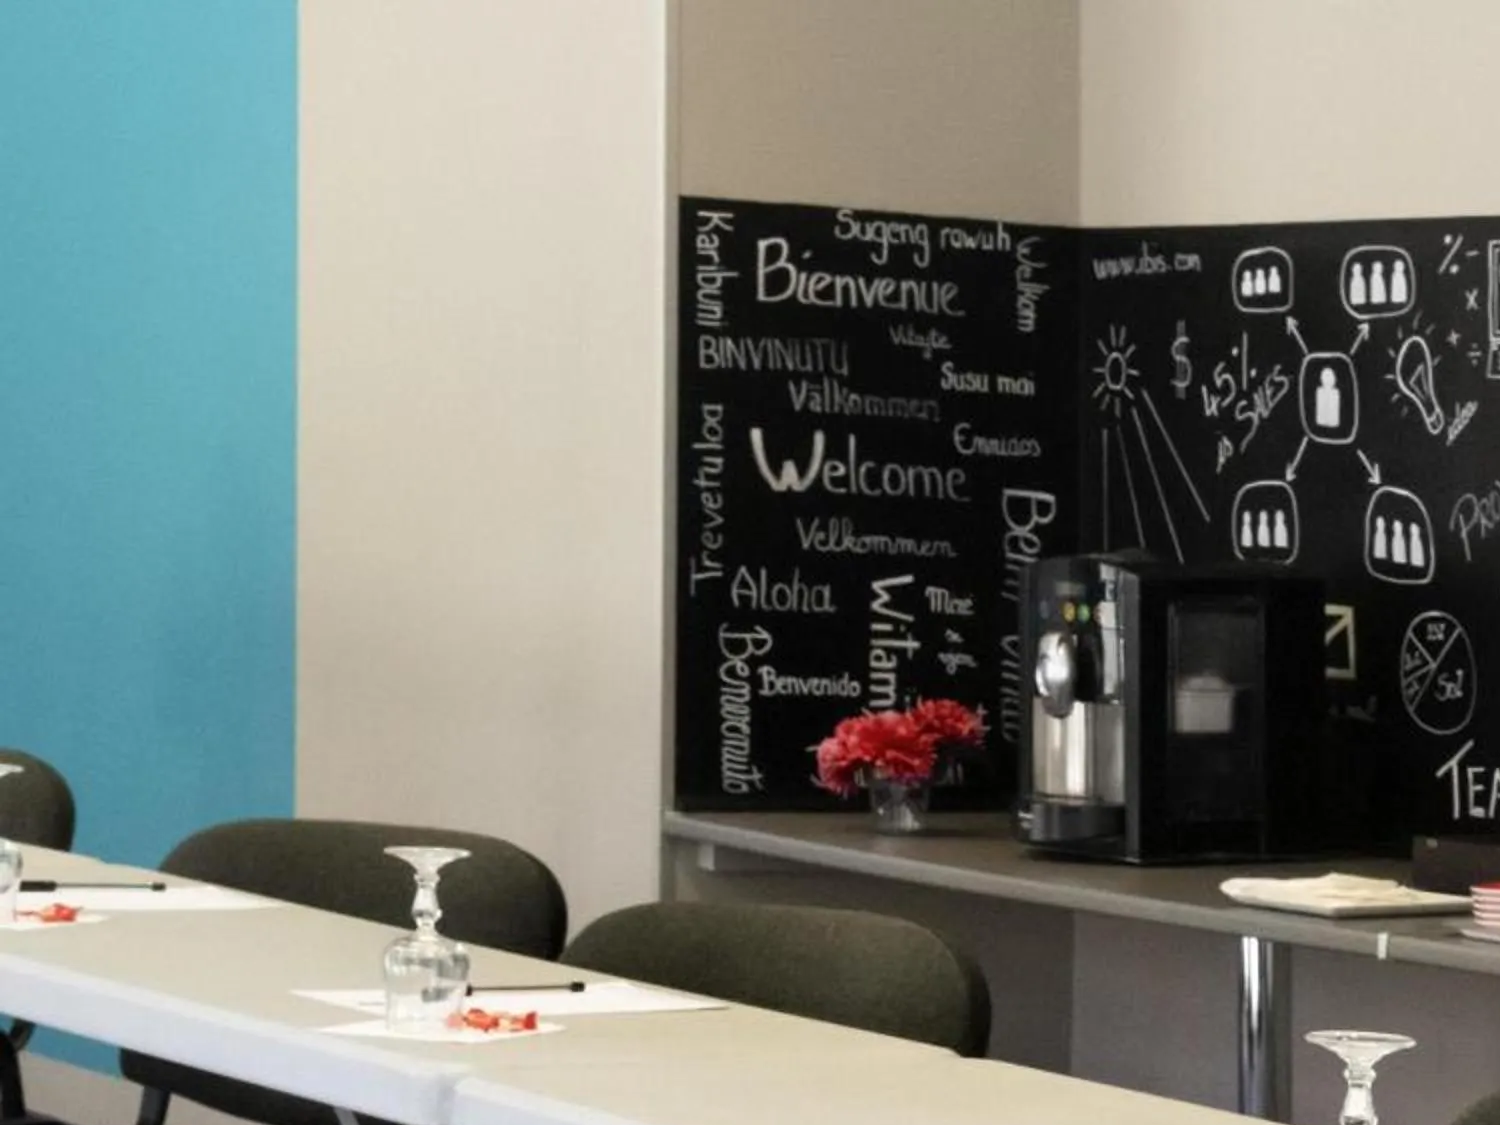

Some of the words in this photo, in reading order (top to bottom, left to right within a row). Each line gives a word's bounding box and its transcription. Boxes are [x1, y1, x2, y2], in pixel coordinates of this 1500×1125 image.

[695, 210, 740, 328] Karibuni
[834, 208, 930, 267] Sugeng
[940, 220, 1012, 252] rawuh
[755, 236, 966, 317] Bienvenue
[940, 361, 990, 393] Susu
[749, 426, 971, 502] Welcome
[730, 565, 838, 614] Aloha
[868, 574, 921, 708] Witam
[756, 665, 862, 698] Benvenido
